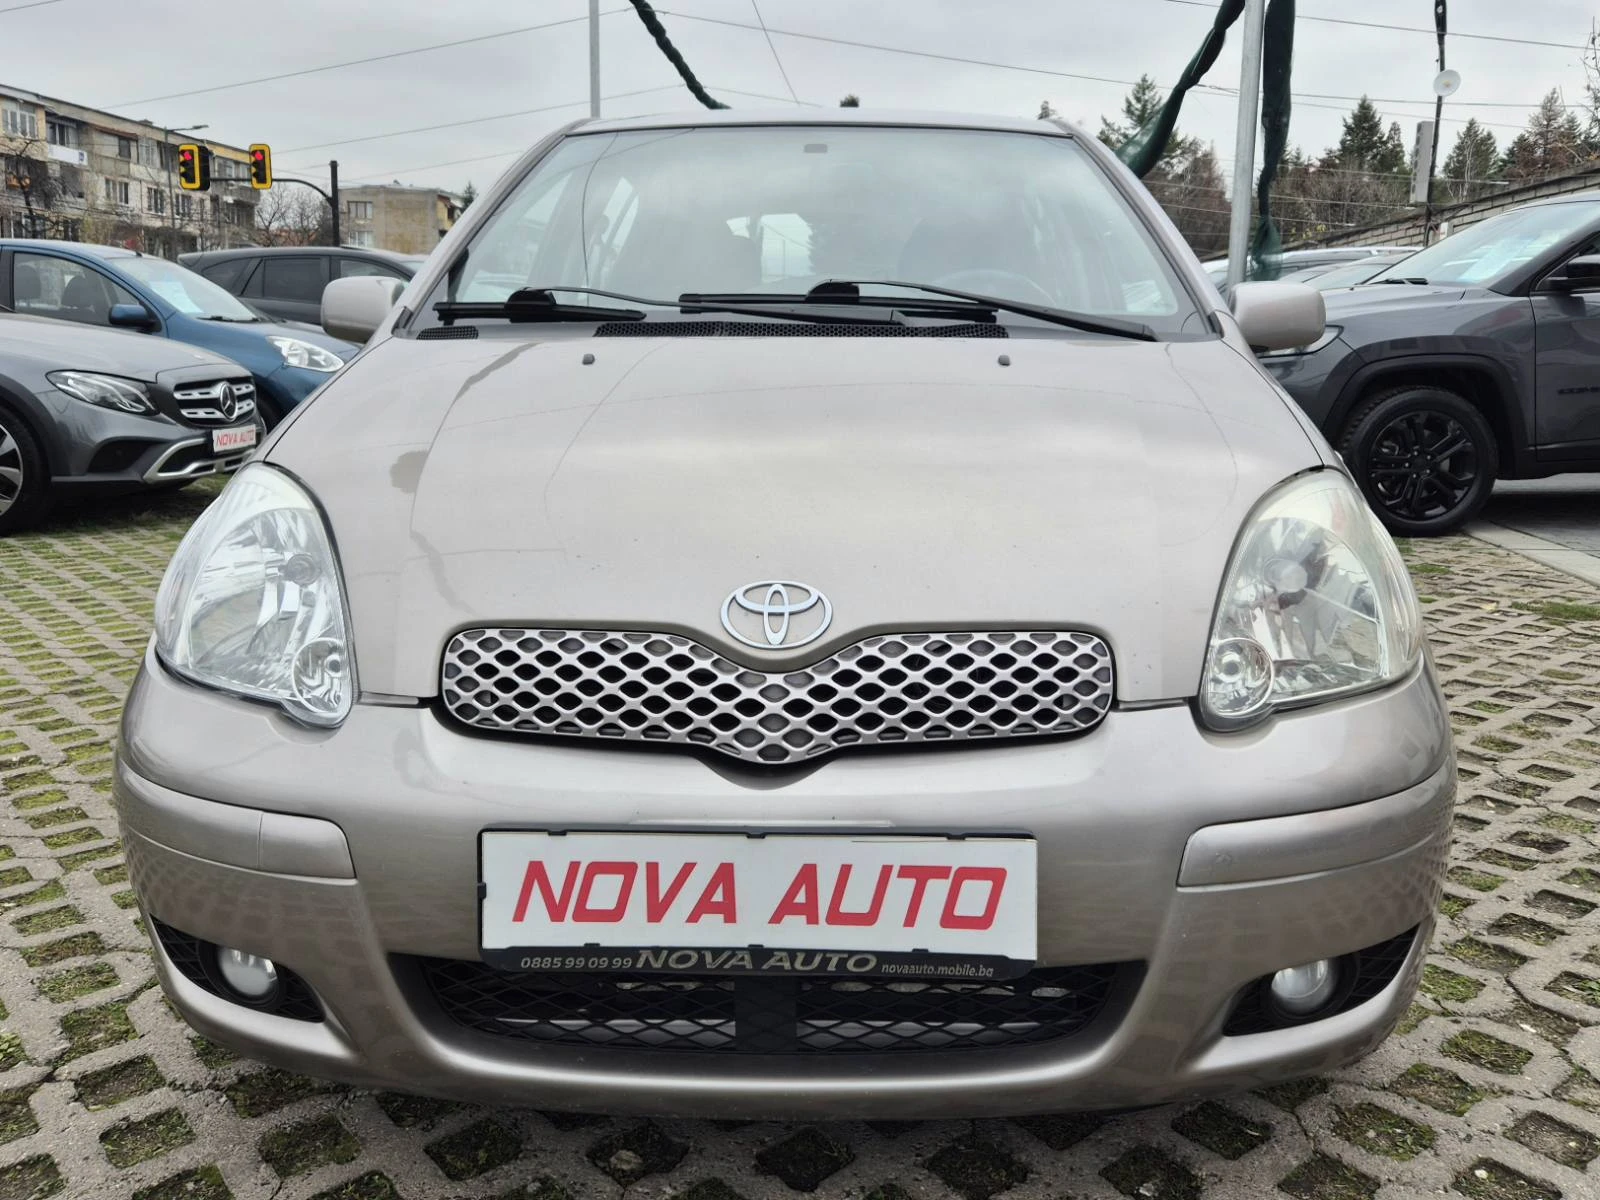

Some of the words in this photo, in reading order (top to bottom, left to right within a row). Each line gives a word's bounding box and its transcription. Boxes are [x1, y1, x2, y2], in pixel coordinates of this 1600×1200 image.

[216, 432, 238, 447] NOVA
[512, 860, 737, 924] NOVA
[767, 863, 1007, 931] AUTO
[520, 957, 562, 969] 0885
[565, 957, 585, 969] 99
[588, 957, 609, 969] 09
[612, 957, 632, 969] 99
[636, 950, 753, 969] NOVA
[761, 951, 878, 972] AUTO
[881, 963, 994, 978] novaauto.mobile.bg
